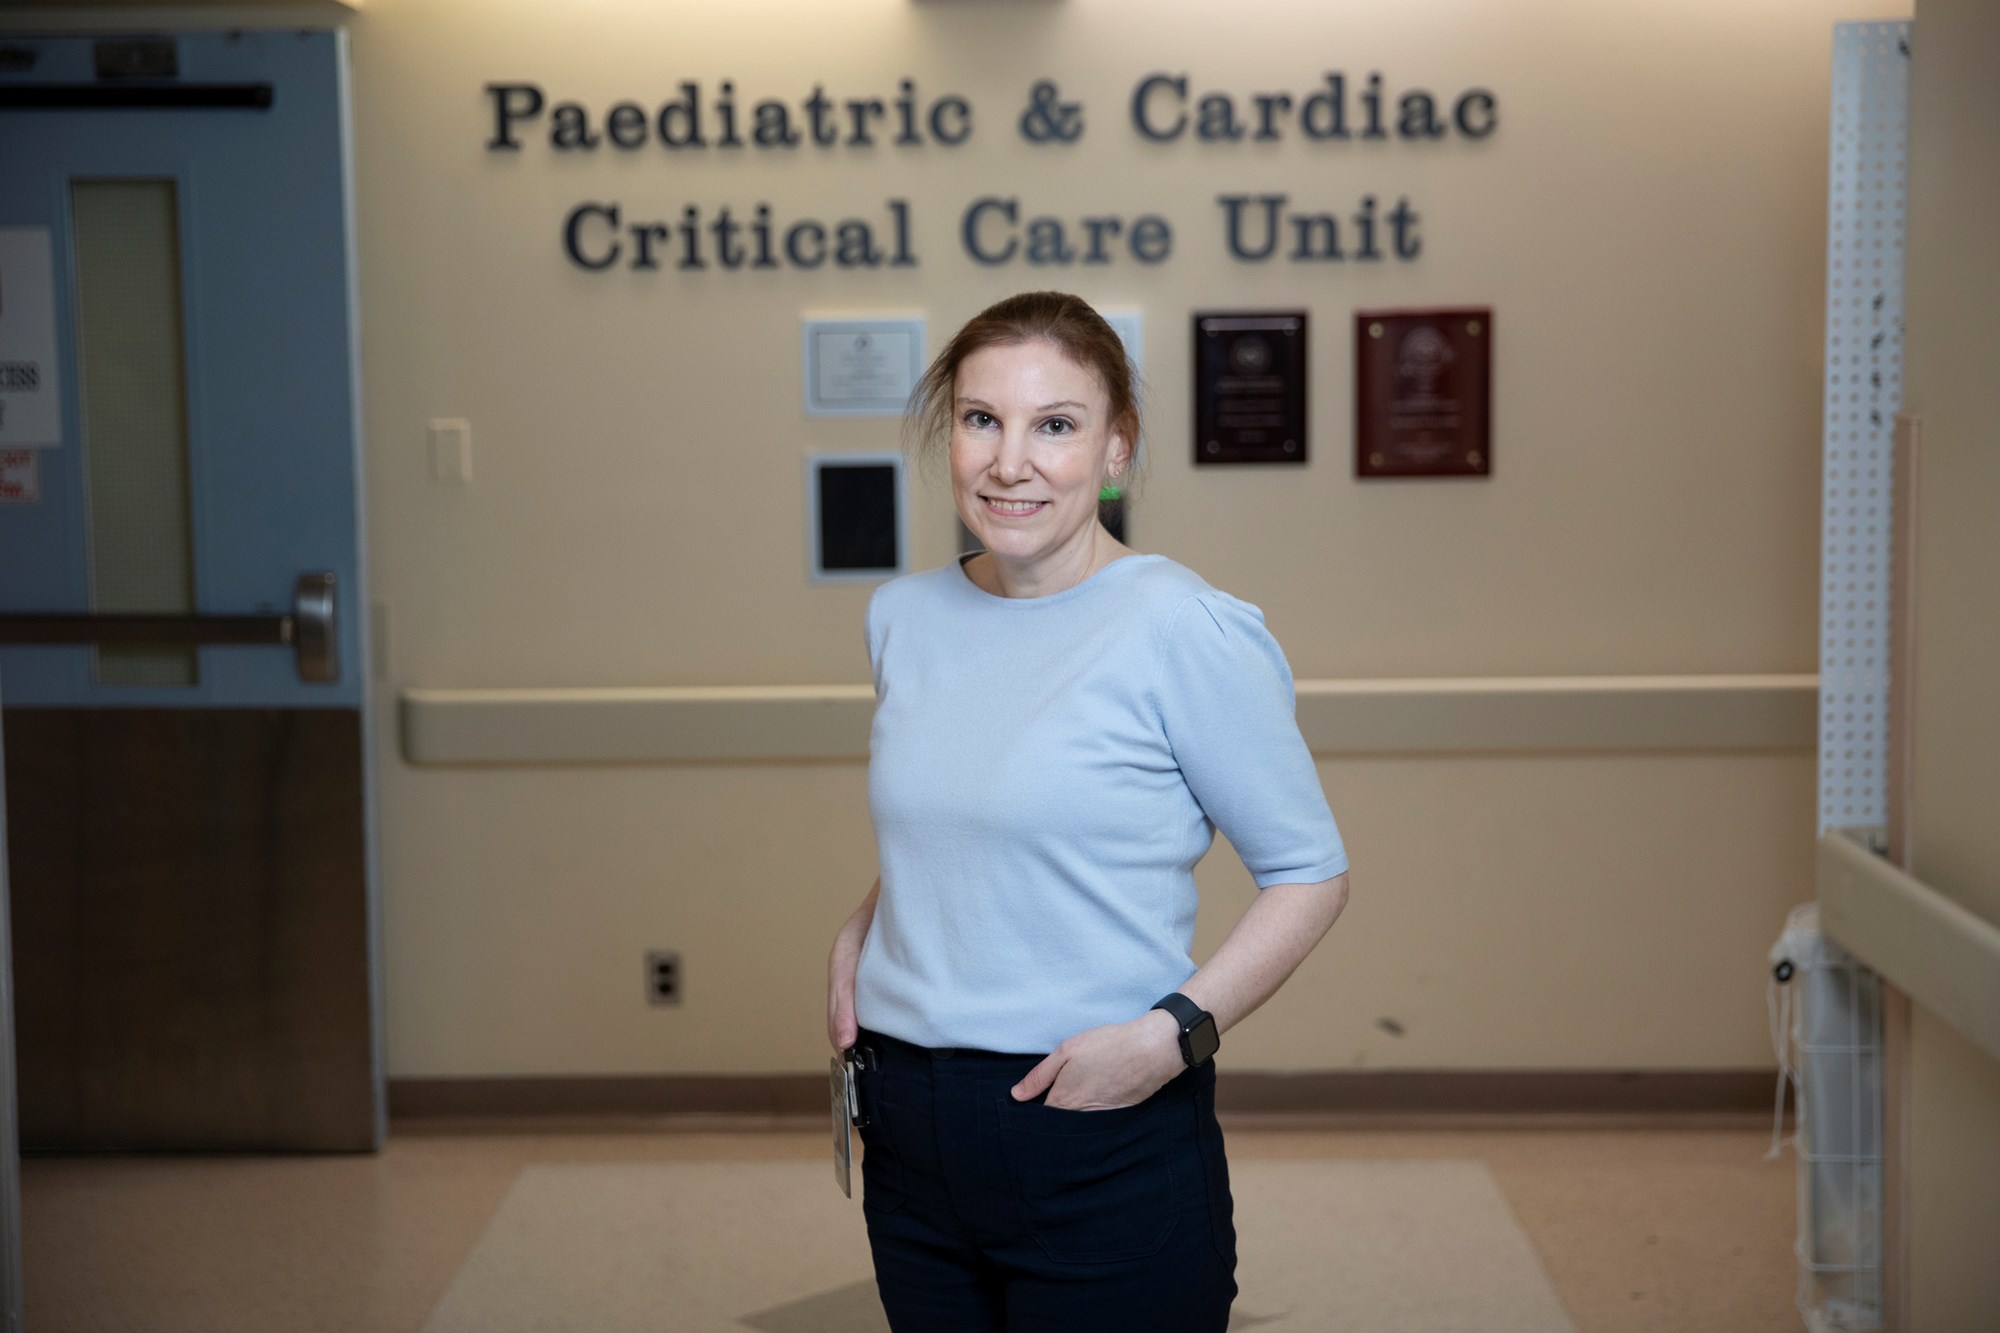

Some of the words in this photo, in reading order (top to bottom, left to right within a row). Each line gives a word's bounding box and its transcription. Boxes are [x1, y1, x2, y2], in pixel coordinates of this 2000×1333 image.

[486, 79, 971, 151] Paediatric
[1020, 81, 1083, 143] &
[1131, 73, 1497, 142] Cardiac
[563, 201, 916, 271] Critical
[962, 198, 1171, 265] Care
[1218, 195, 1420, 261] Unit
